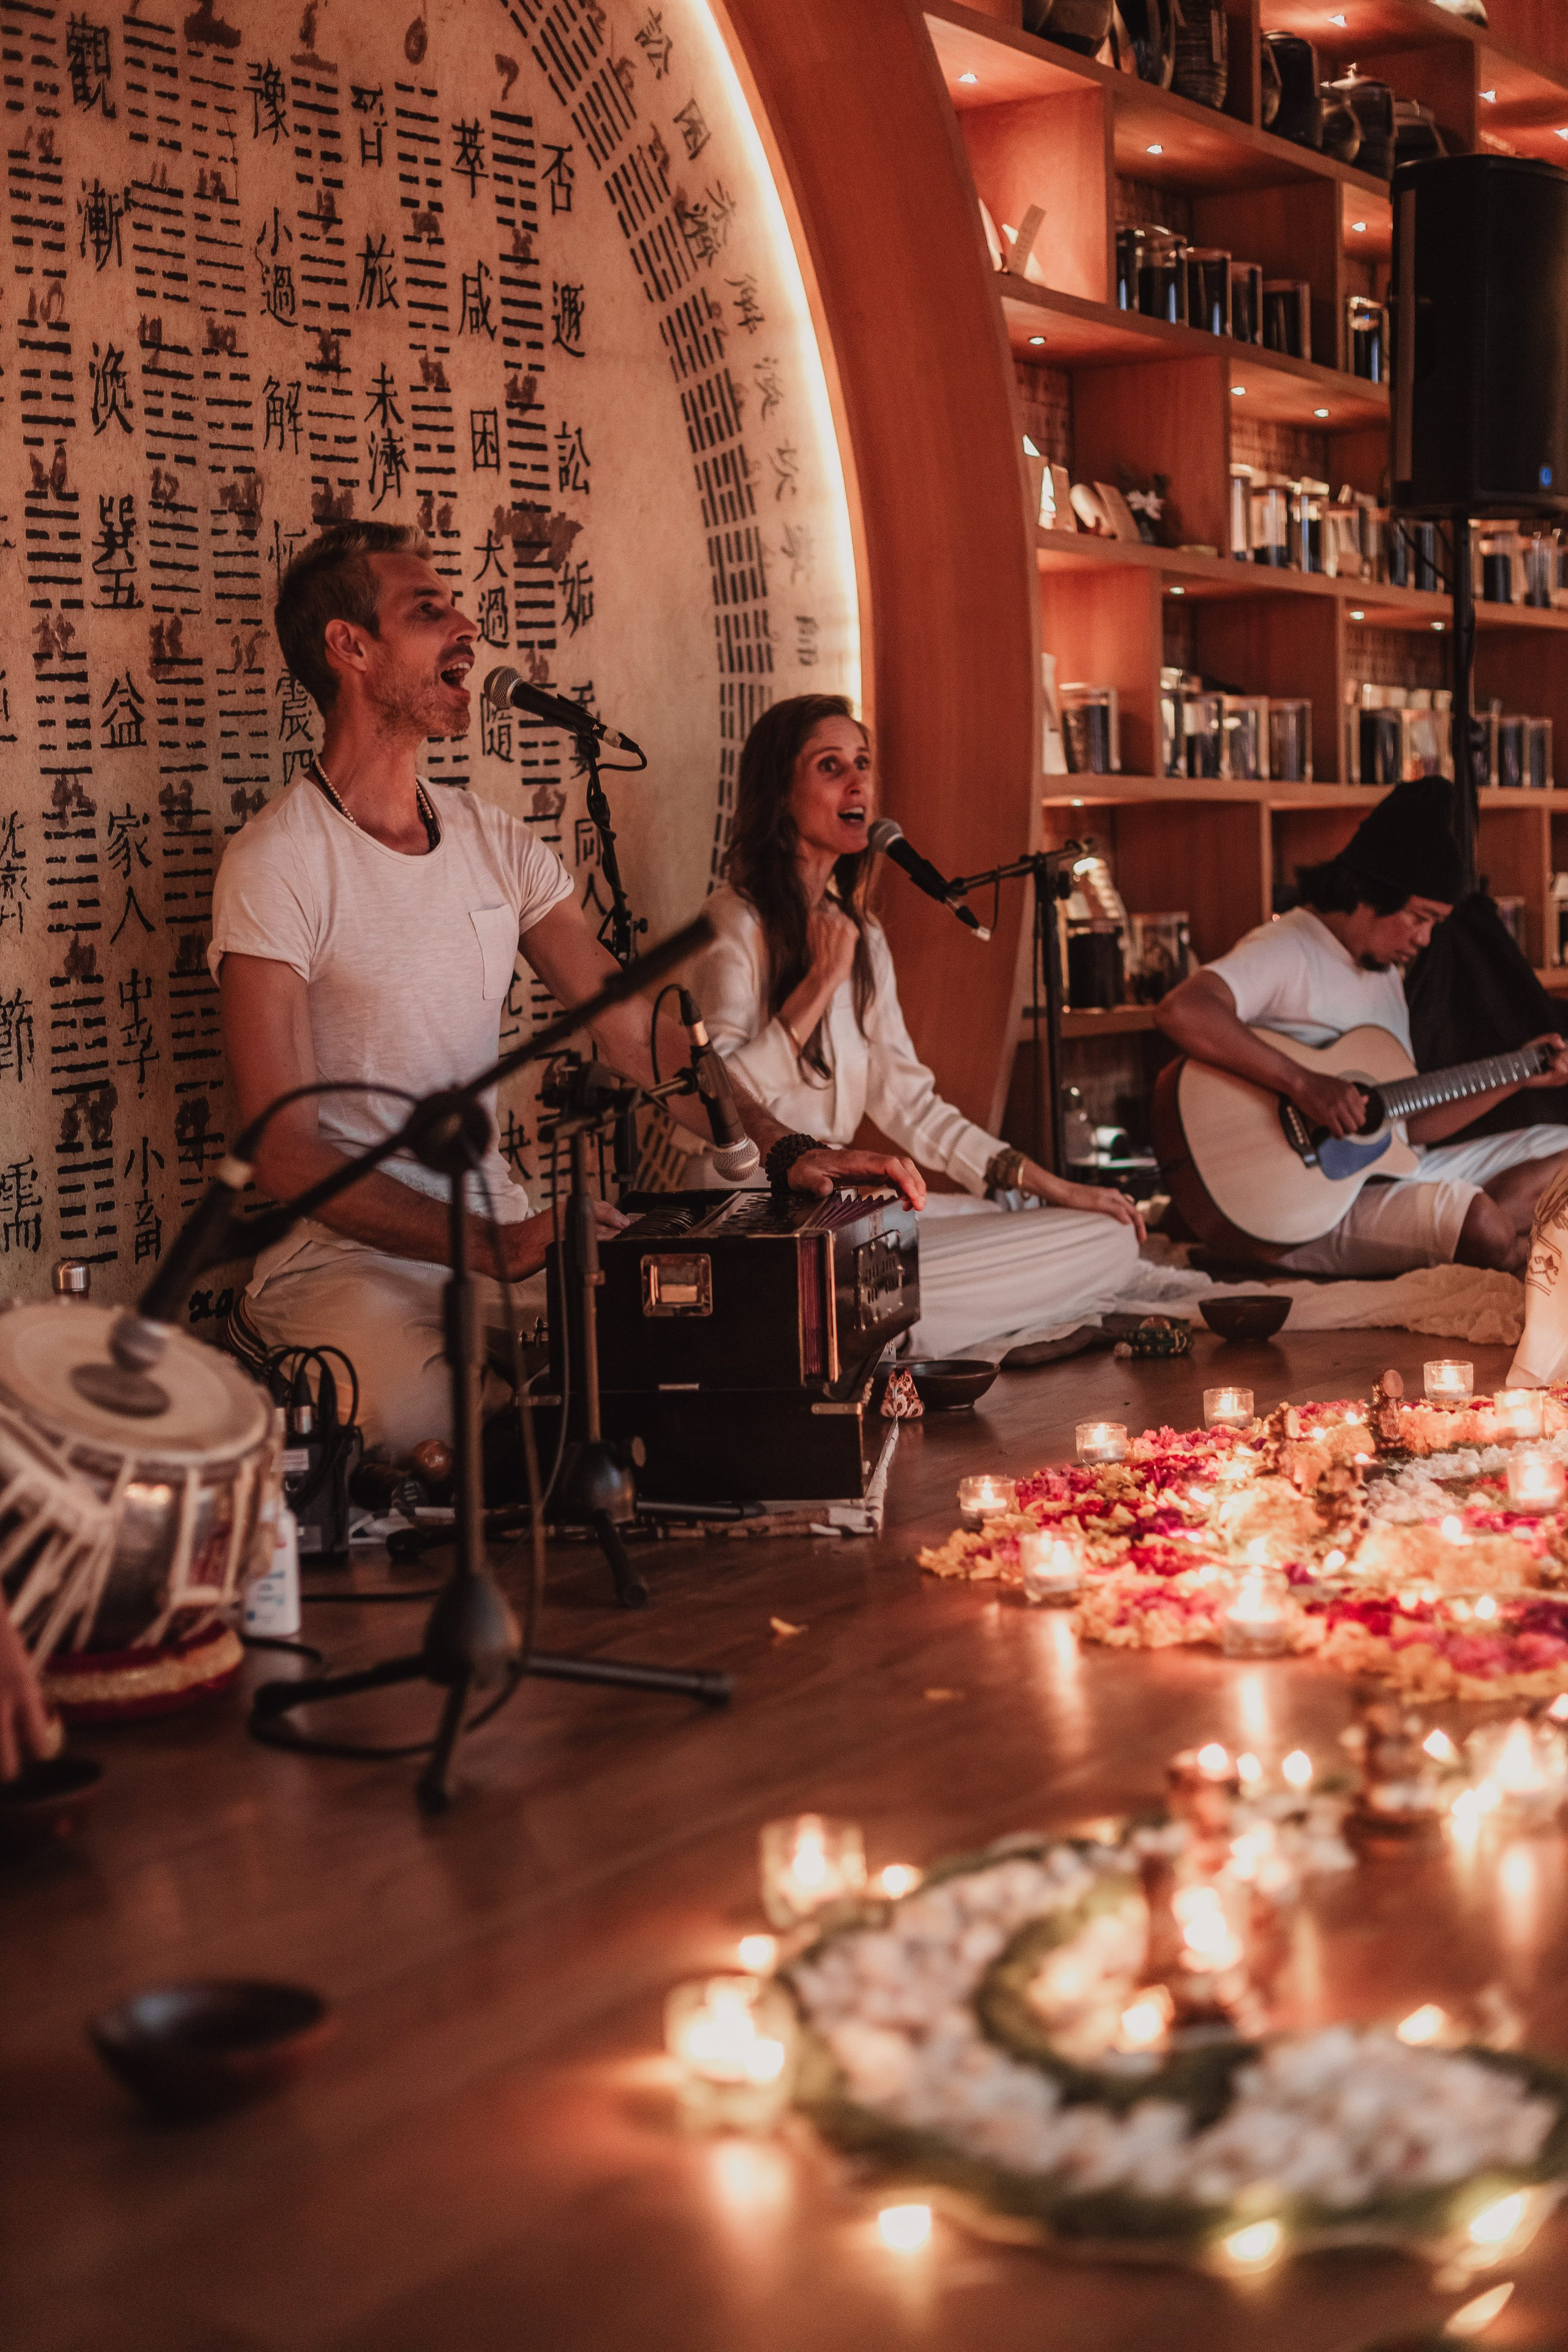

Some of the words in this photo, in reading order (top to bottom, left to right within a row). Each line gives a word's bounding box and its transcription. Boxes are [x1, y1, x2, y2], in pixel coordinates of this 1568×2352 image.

[65, 12, 118, 121] 觀
[242, 58, 290, 145] 豫
[349, 84, 389, 168] 晉
[450, 118, 490, 200] 萃
[673, 97, 712, 160] 困
[541, 143, 576, 216] 否
[76, 178, 126, 273] 漸
[254, 206, 299, 328] 小過
[355, 233, 401, 311] 旅
[458, 259, 498, 342] 咸
[551, 280, 586, 359] 遯
[88, 341, 135, 437] 渙
[262, 374, 304, 456] 解
[363, 361, 410, 512] 未濟
[469, 407, 502, 474] 困
[553, 420, 592, 496] 訟
[473, 528, 510, 650] 大過
[555, 556, 594, 638] 姤
[100, 670, 148, 750] 益
[107, 802, 157, 946] 家人
[575, 817, 610, 919] 同人
[116, 967, 162, 1100] 中孚
[123, 1136, 168, 1267] 小畜
